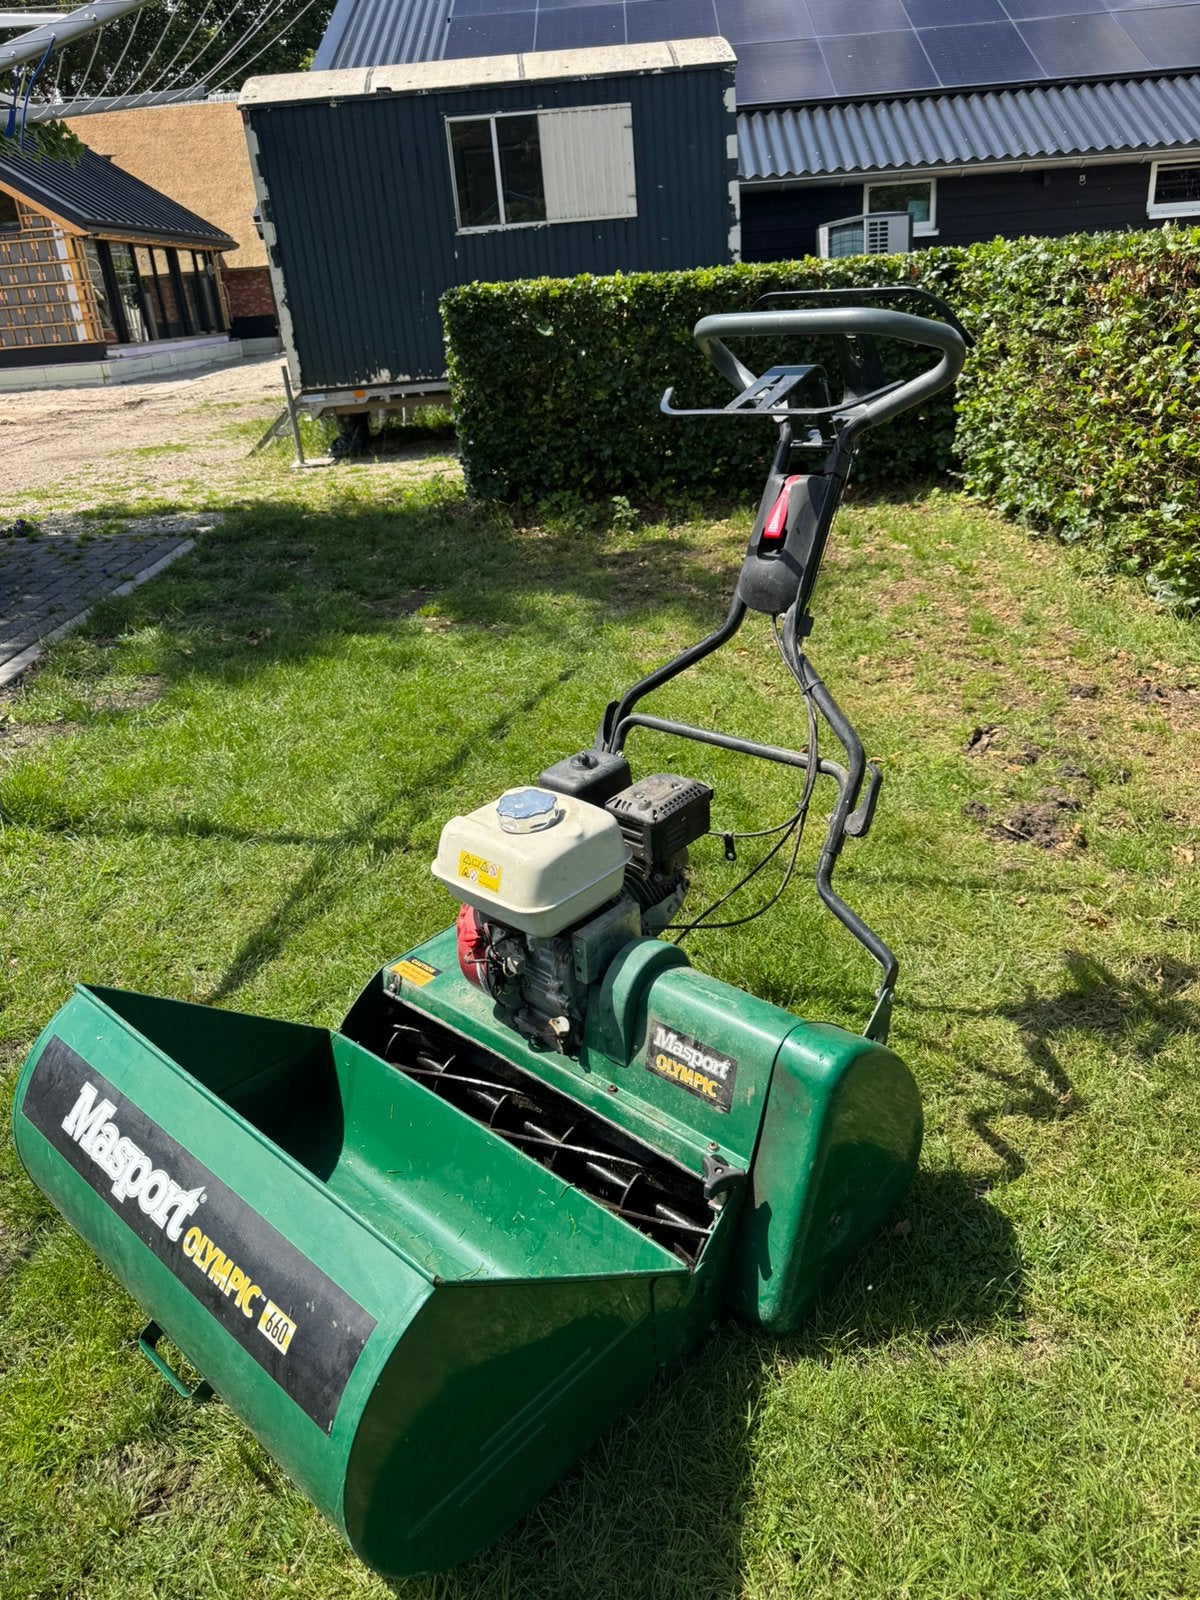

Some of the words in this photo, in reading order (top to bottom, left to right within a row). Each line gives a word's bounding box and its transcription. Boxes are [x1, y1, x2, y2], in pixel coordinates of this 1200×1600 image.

[652, 1026, 731, 1080] Masport
[656, 1054, 718, 1098] OLYMPIC
[61, 1081, 206, 1242] Masport
[182, 1226, 262, 1318] OLYMPIC
[264, 1311, 289, 1346] 660
